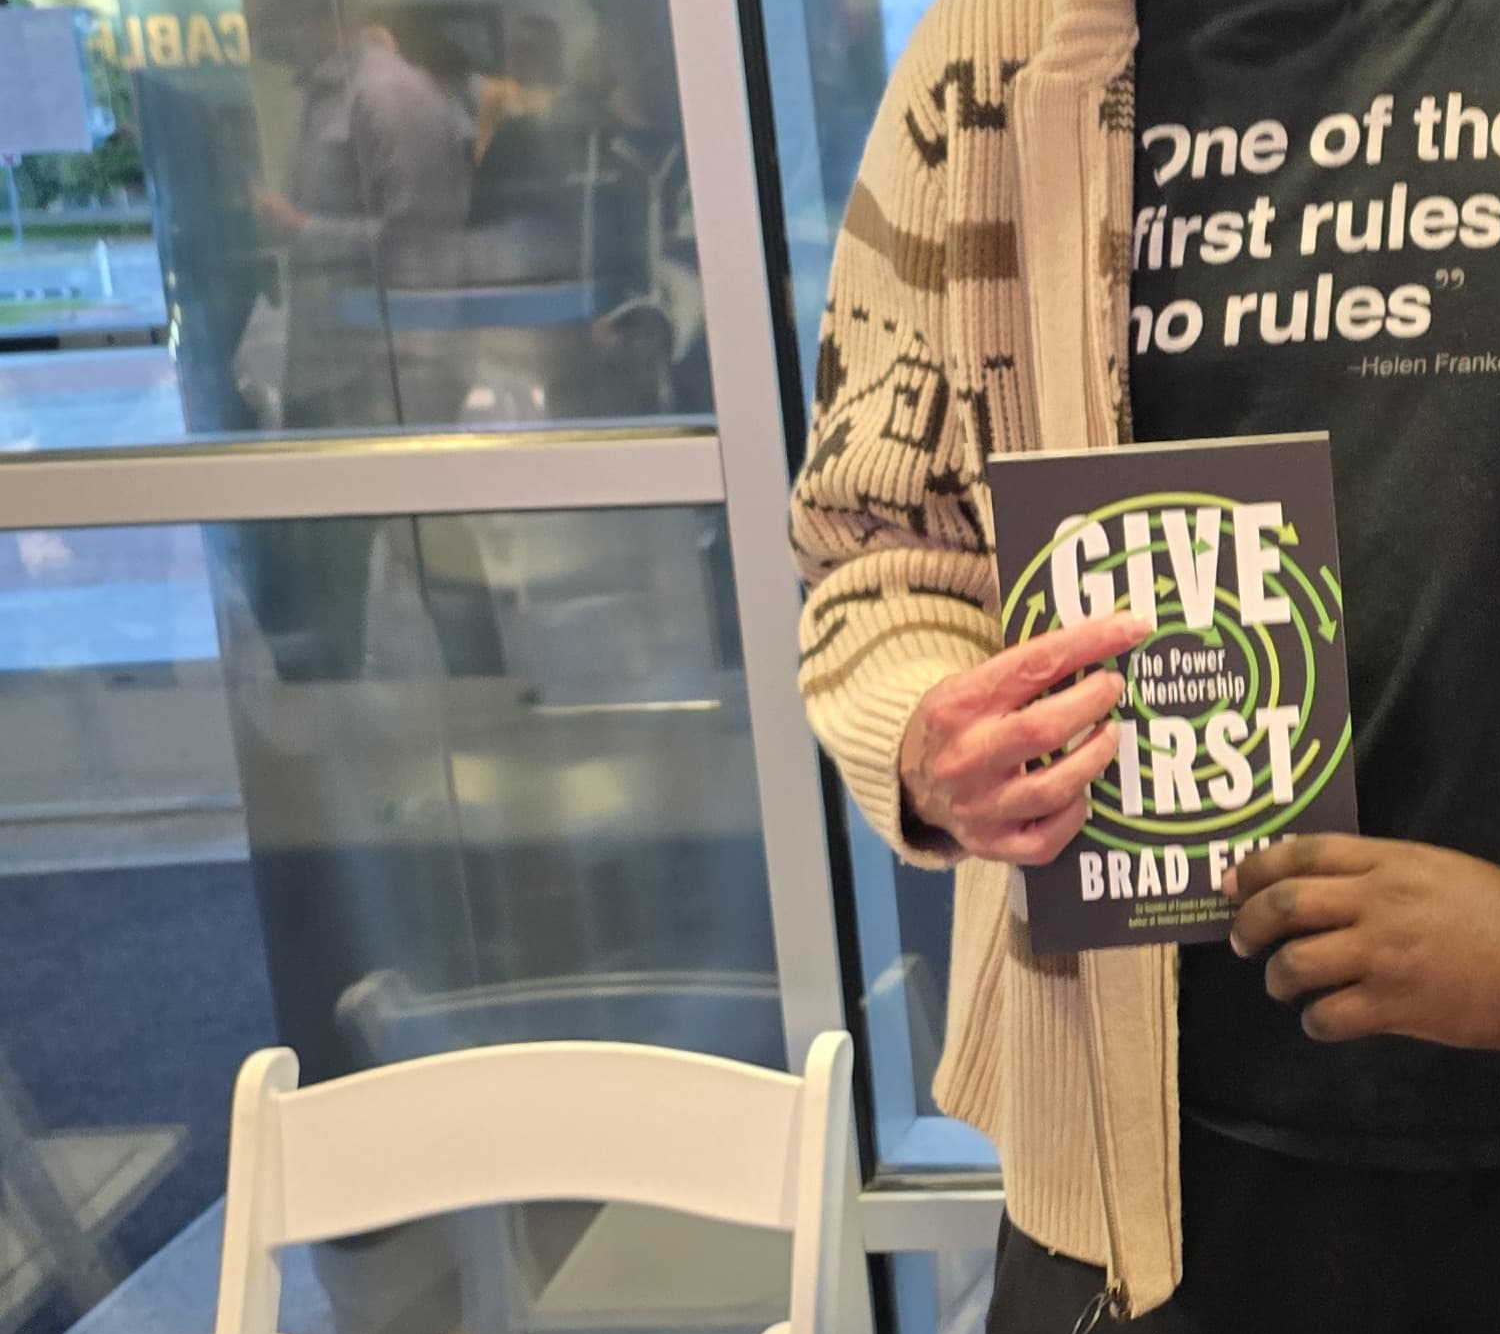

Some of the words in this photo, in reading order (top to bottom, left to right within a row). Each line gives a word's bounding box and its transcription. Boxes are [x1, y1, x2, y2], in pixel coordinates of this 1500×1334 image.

[1142, 118, 1288, 187] One
[1309, 94, 1394, 167] of
[1133, 195, 1276, 270] first
[1051, 502, 1291, 632] GIVE
[1131, 650, 1163, 679] The
[1170, 647, 1226, 677] Power
[1141, 671, 1245, 705] Mentorship
[1068, 705, 1300, 820] IRST
[1079, 843, 1190, 902] BRAD
